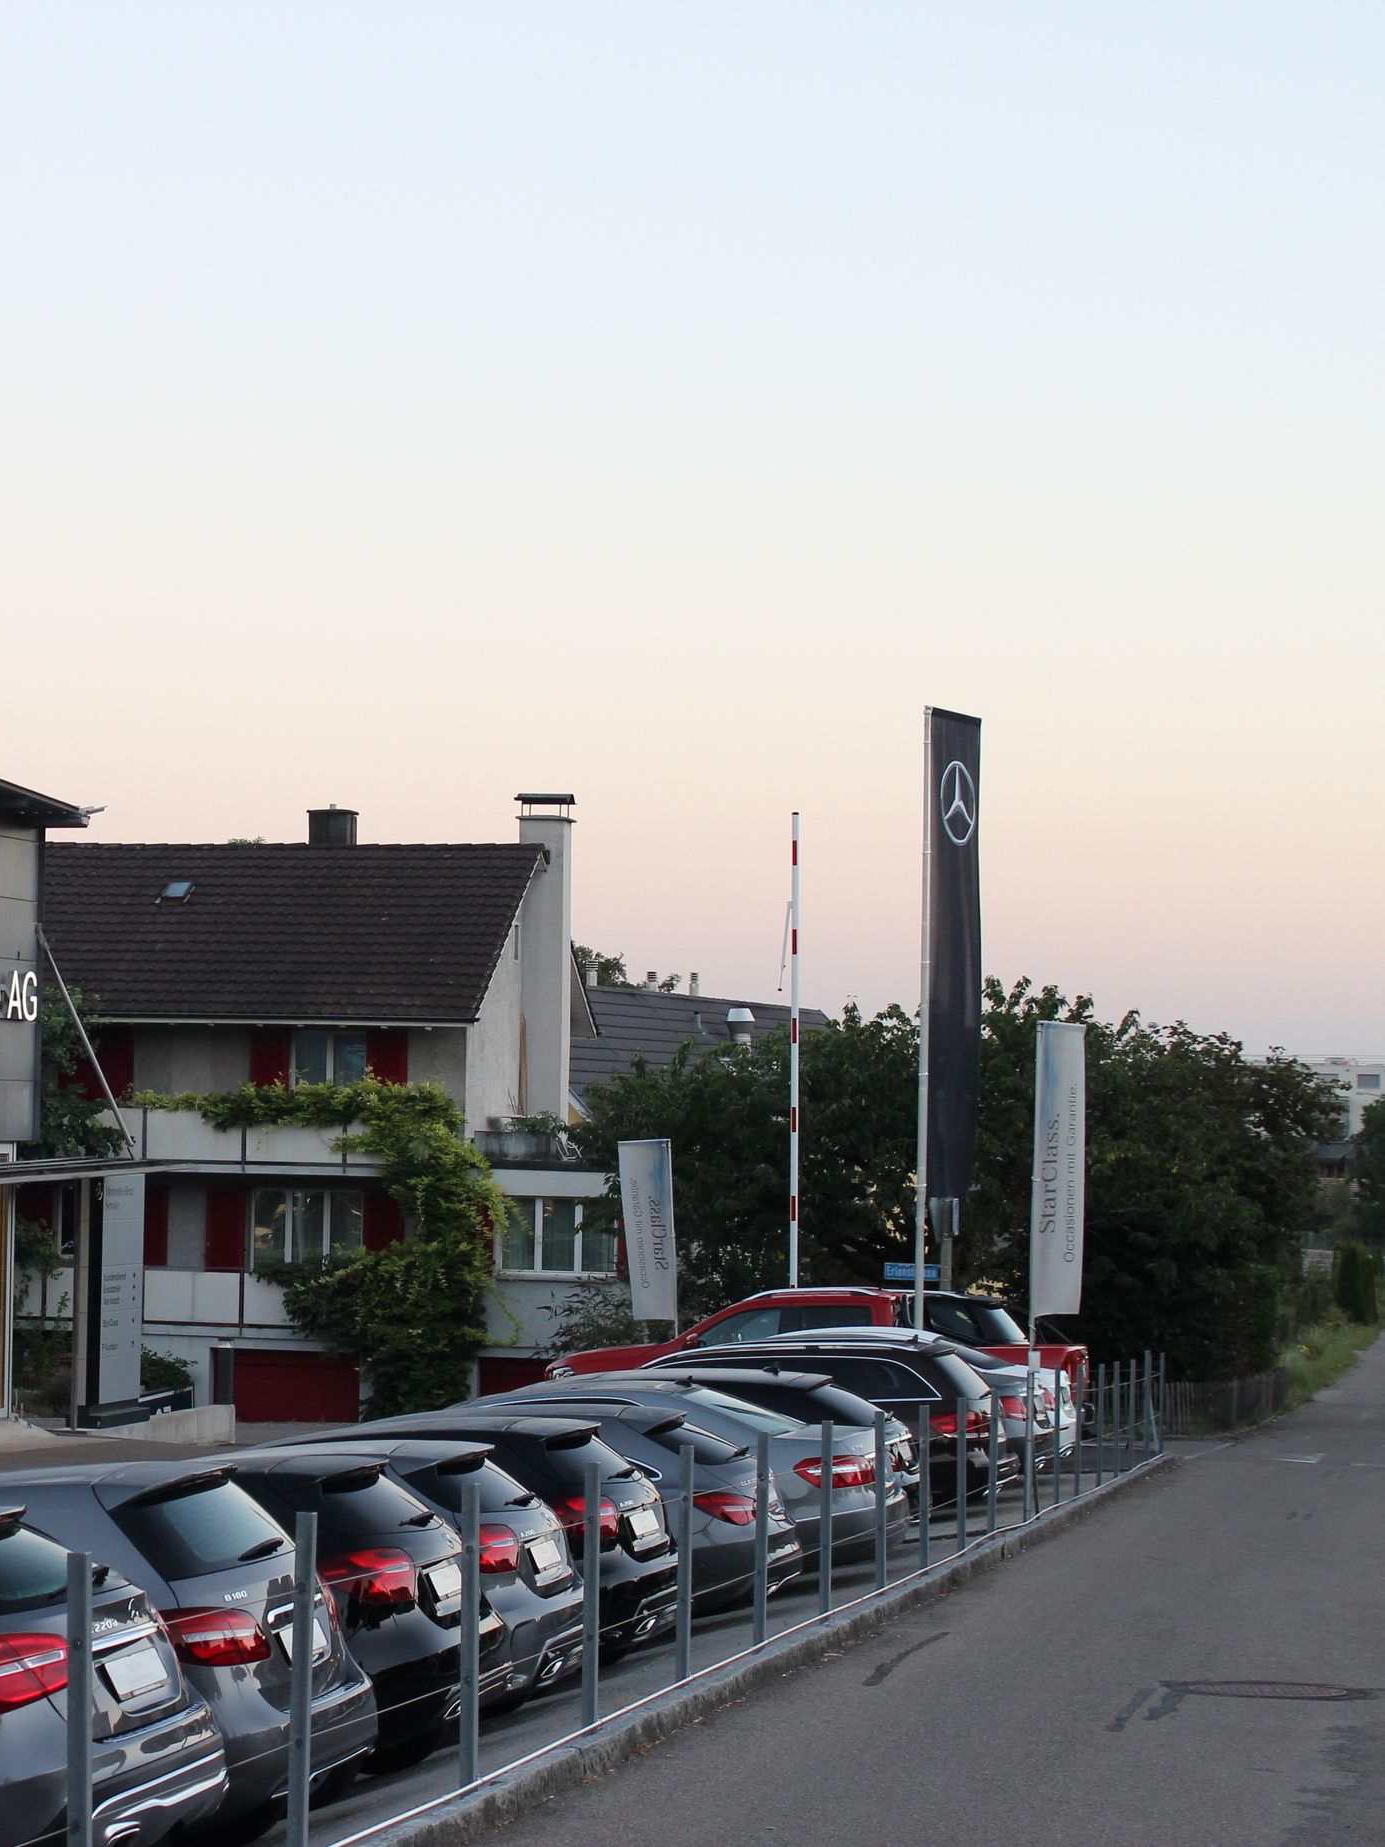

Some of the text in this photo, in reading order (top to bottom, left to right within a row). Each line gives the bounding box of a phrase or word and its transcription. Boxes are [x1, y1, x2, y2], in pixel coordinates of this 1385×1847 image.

[6, 970, 38, 1021] AG
[1039, 1113, 1060, 1234] StarClass.
[1063, 1083, 1078, 1263] Occasionen mit Garantie.
